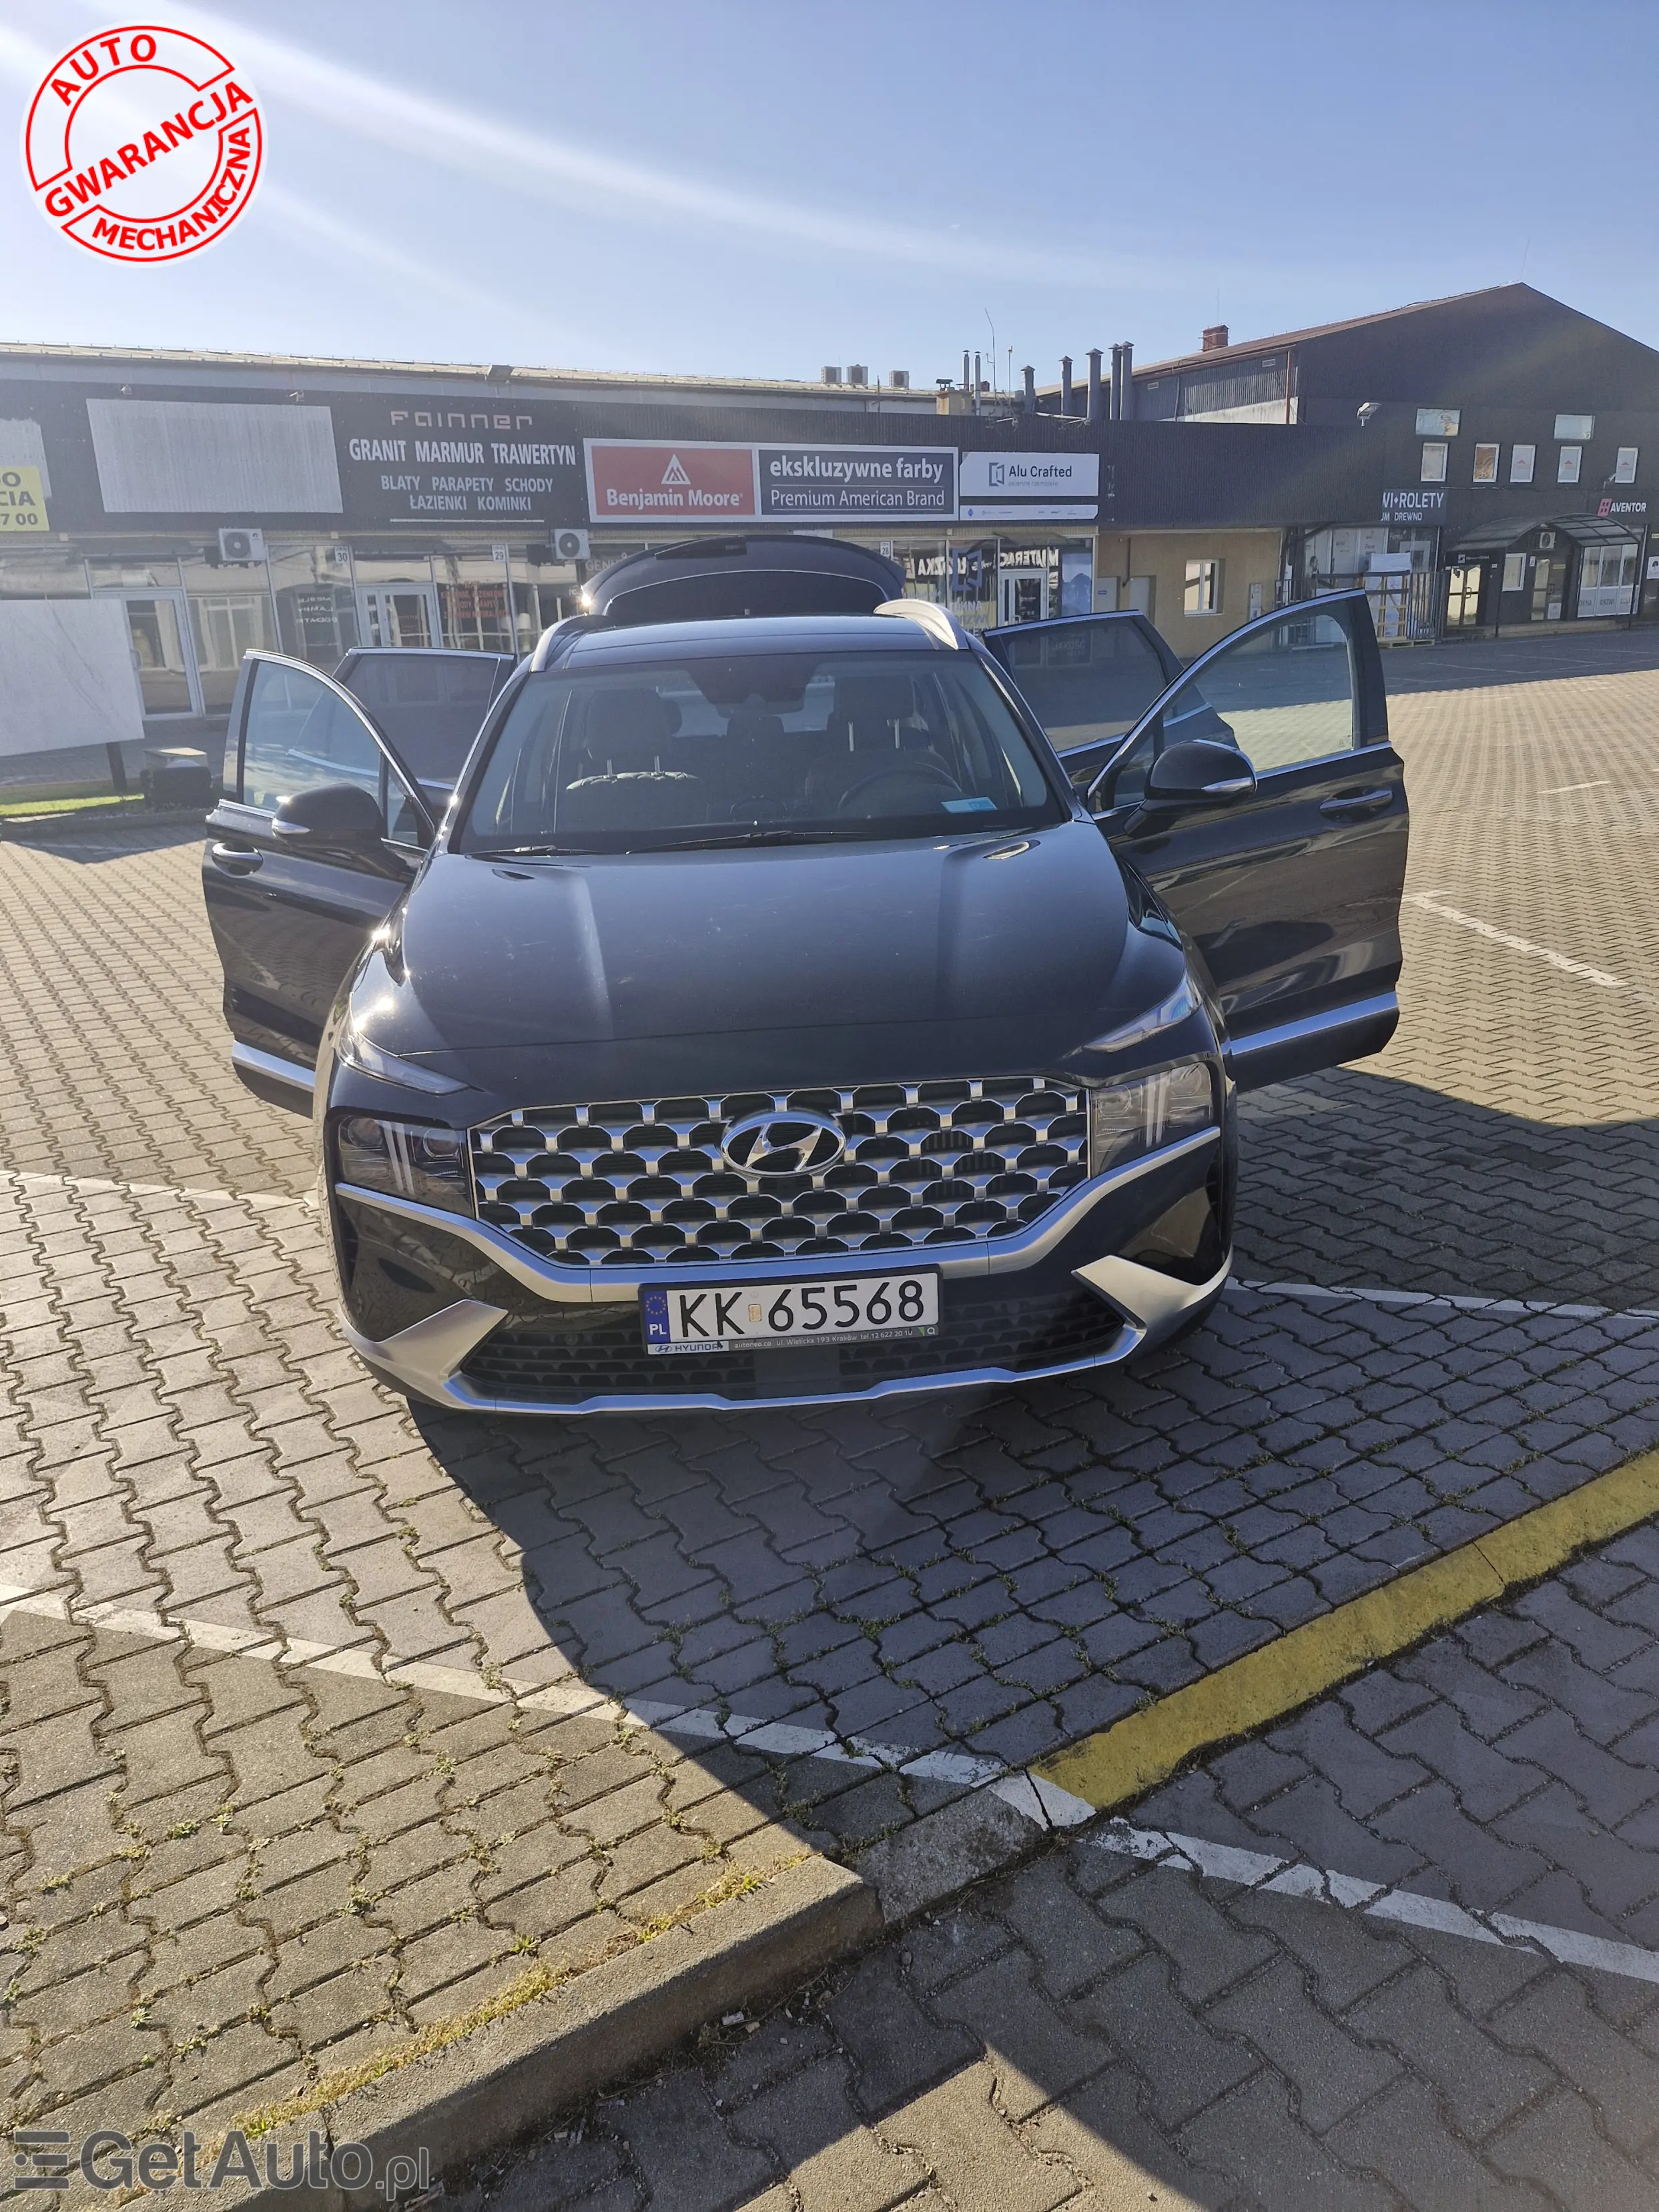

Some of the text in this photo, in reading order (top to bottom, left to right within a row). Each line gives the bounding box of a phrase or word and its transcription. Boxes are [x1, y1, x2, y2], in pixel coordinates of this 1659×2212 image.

[349, 438, 577, 466] GRANIT MARMUR TRAWERTYN
[769, 455, 944, 483] ekskluzywne farby
[1009, 464, 1072, 478] Alu Crafted
[381, 475, 553, 492] BLATY PARAPETY SCHODY
[410, 494, 532, 511] ŁAZIENKI KOMINKI
[607, 488, 683, 510] Benjamin
[771, 490, 945, 506] Premium American Brand
[1610, 502, 1647, 512] AVENTOR
[1394, 512, 1423, 521] DREWNO
[337, 552, 348, 562] 30
[495, 551, 504, 560] 29
[882, 547, 889, 555] 28
[679, 1280, 924, 1337] KK 65568
[649, 1323, 667, 1335] PL
[735, 1340, 771, 1349] autoneo.co
[786, 1335, 814, 1345] Wielicka
[817, 1335, 830, 1343] 193
[832, 1334, 858, 1342] Kraków
